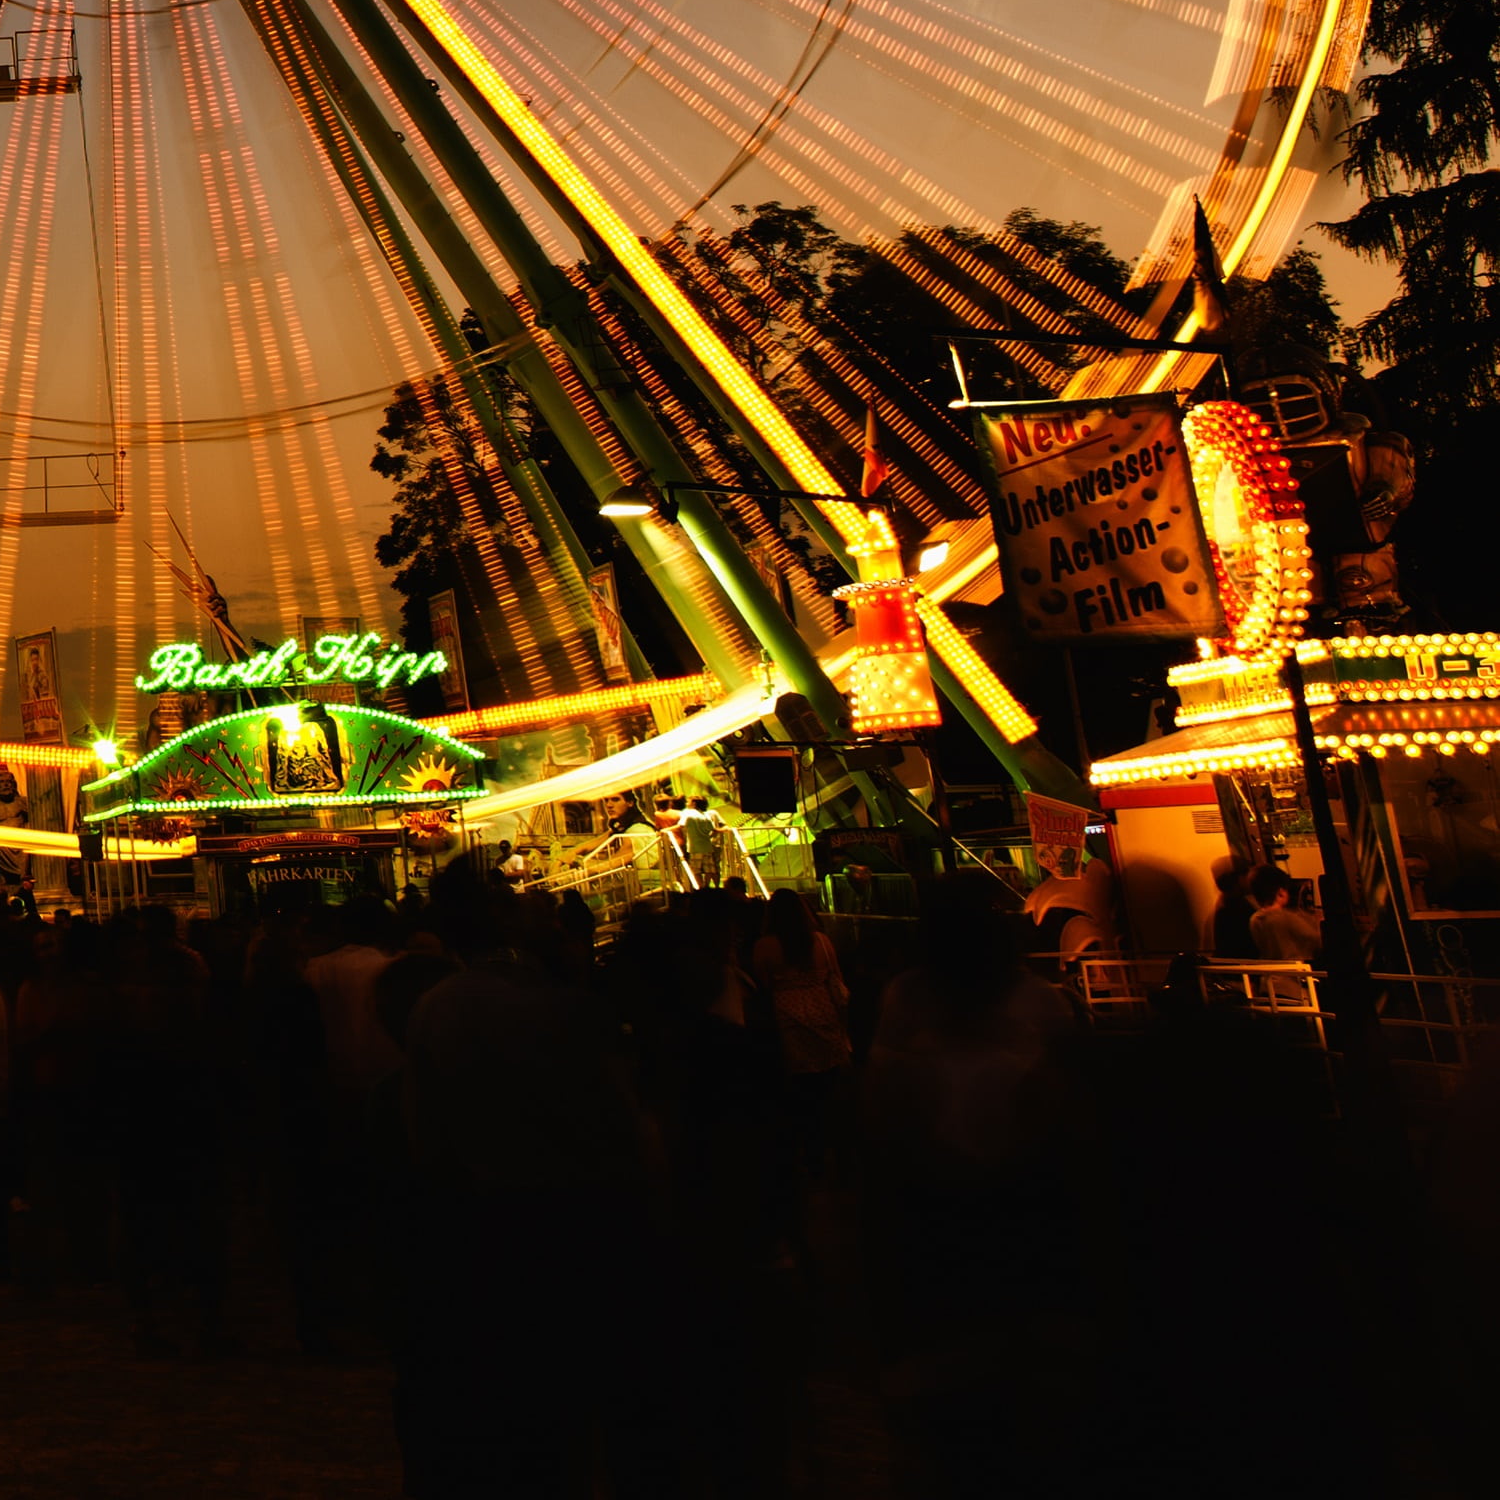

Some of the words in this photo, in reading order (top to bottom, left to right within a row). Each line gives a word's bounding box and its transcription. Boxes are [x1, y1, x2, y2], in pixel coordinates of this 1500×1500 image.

[1000, 409, 1092, 465] Neu:
[1002, 440, 1177, 536] Unterwasser-
[1049, 517, 1170, 583] Action-
[1073, 577, 1166, 633] Film
[135, 638, 298, 691] Barth
[303, 631, 448, 687] Kipp
[248, 867, 356, 884] FAHRKARTEN
